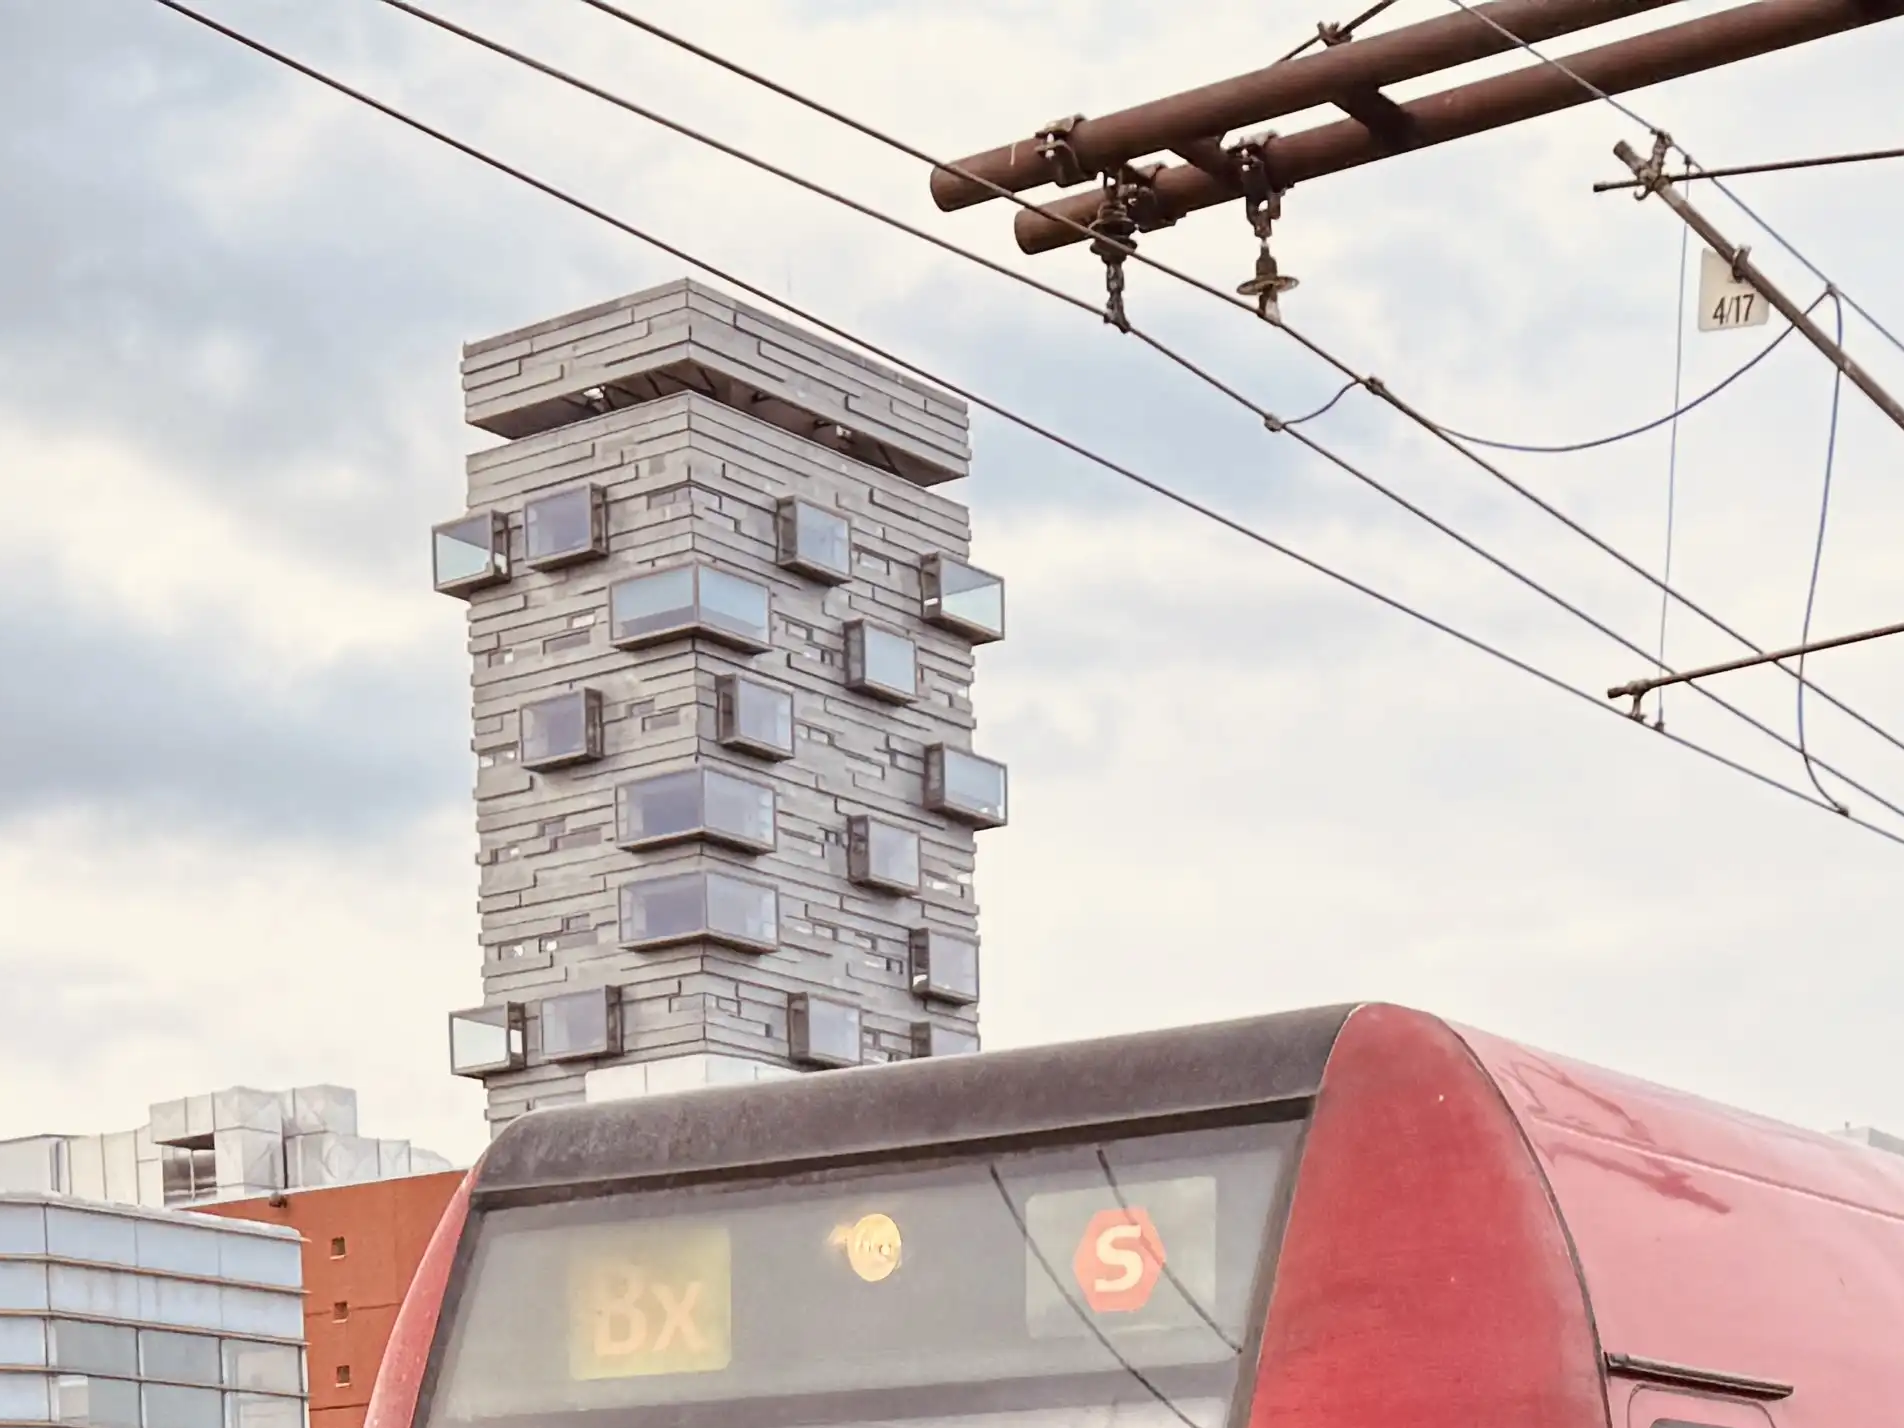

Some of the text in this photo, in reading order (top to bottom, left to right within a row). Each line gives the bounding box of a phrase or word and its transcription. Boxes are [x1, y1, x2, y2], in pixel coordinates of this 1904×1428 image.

[1712, 294, 1754, 325] 4/17
[1094, 1224, 1144, 1292] S
[590, 1264, 708, 1357] Bx
